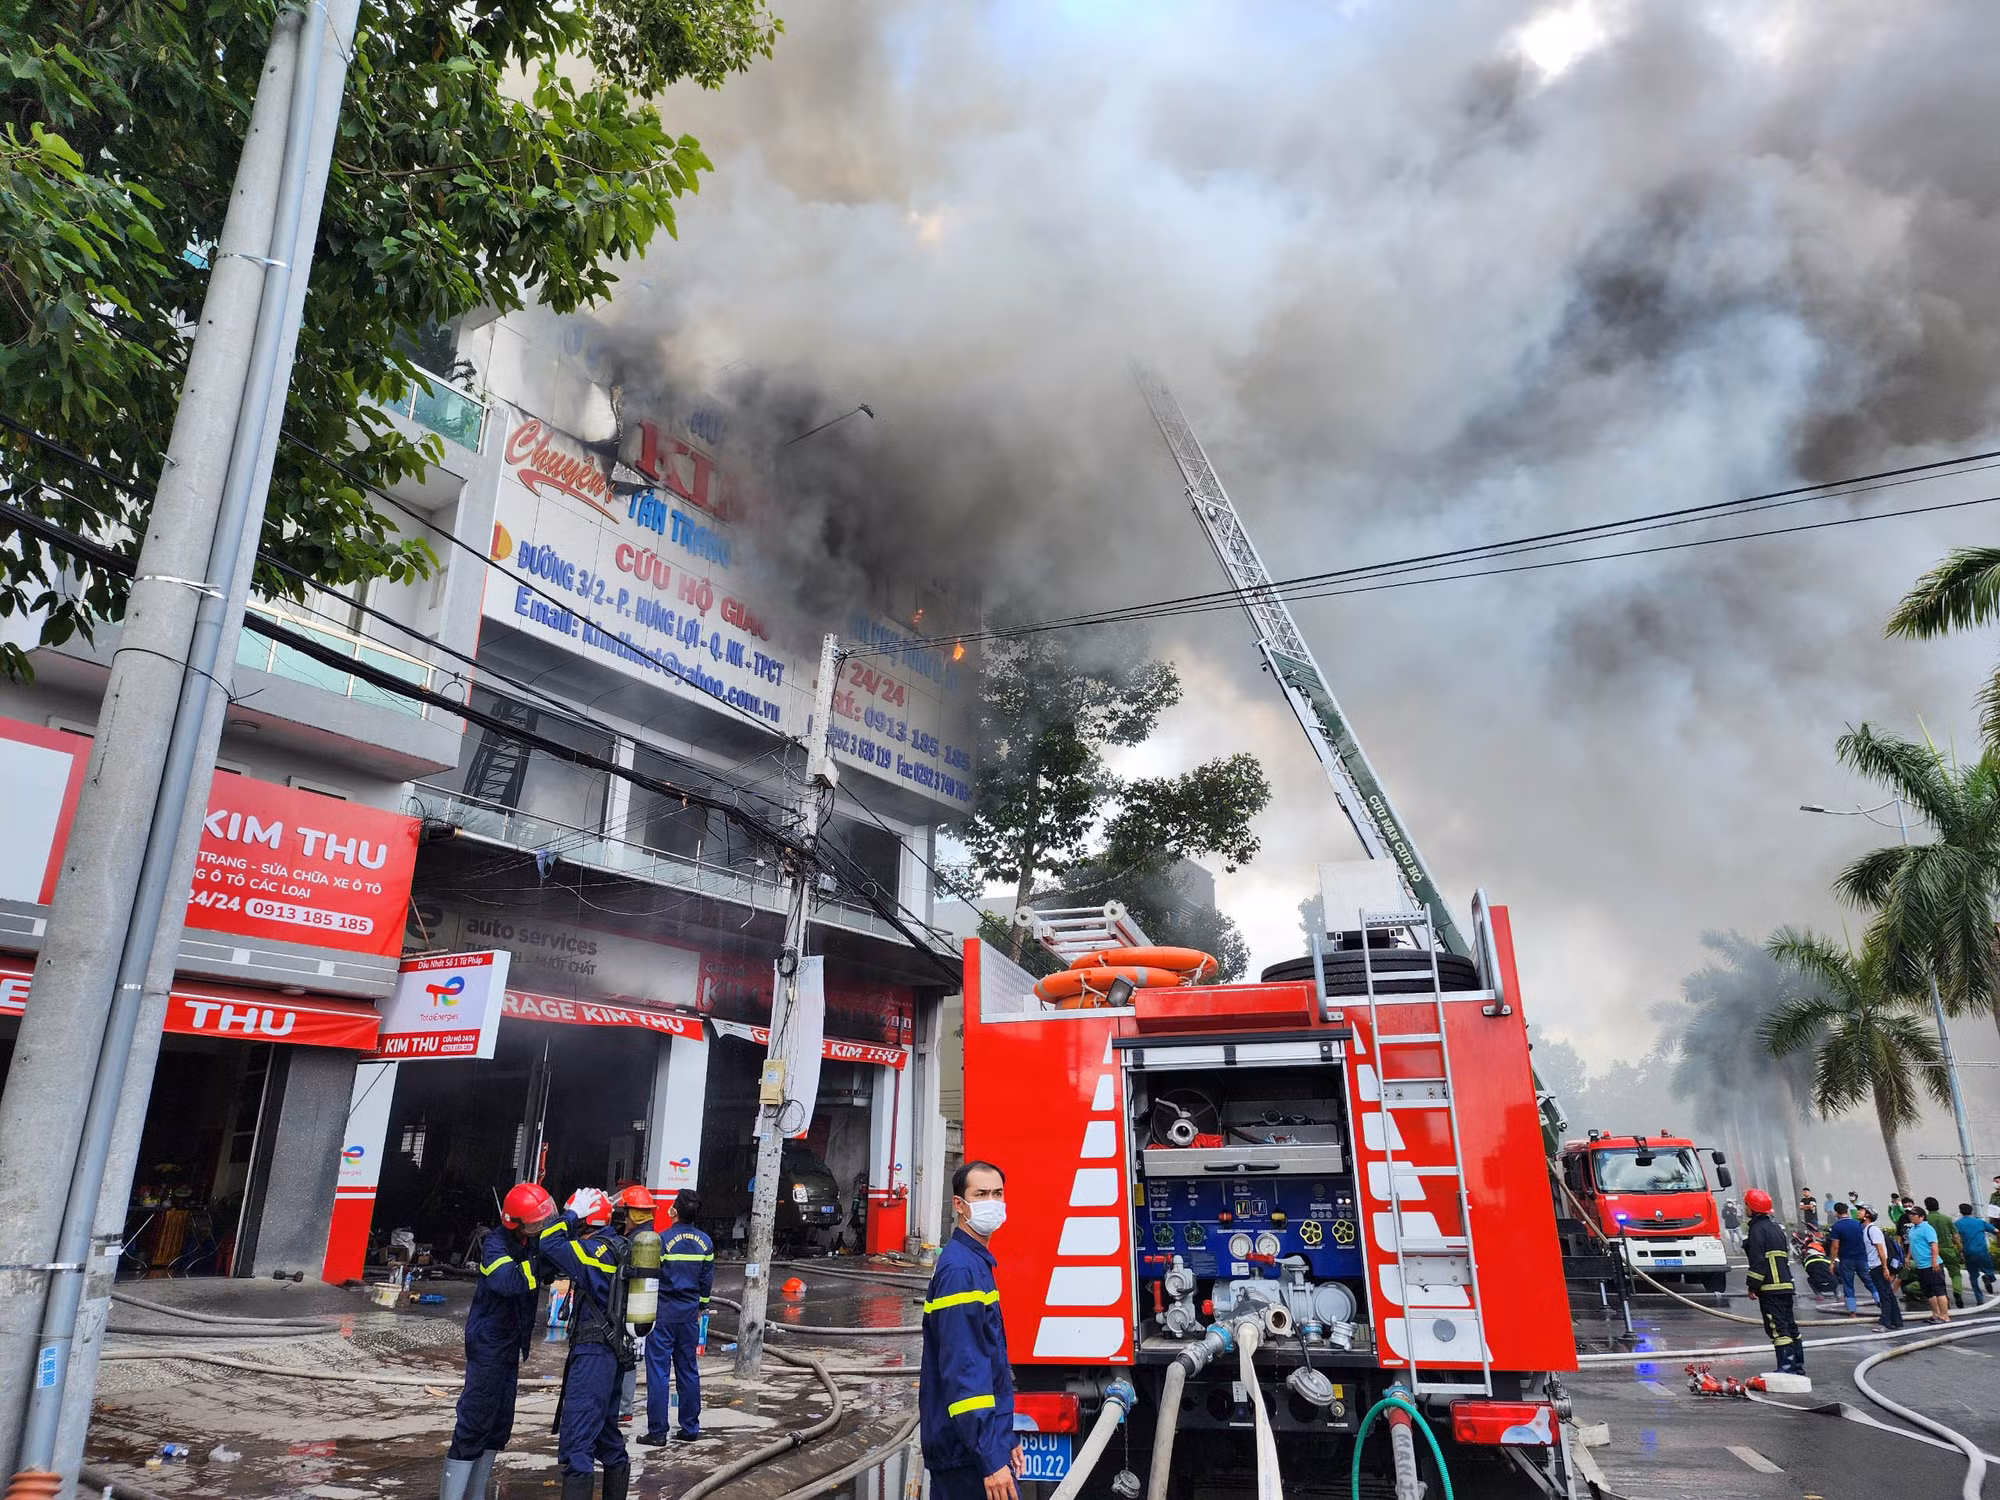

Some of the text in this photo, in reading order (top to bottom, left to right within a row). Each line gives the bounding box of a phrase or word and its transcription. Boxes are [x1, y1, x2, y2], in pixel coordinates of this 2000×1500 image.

[634, 418, 742, 526] KI
[615, 543, 671, 591] CỨU
[678, 577, 714, 617] HỘ
[515, 585, 580, 638] Email:
[517, 541, 575, 593] ĐƯỜNG
[576, 569, 606, 606] 3/2
[616, 588, 631, 618] P.
[676, 616, 700, 650] LỢI
[710, 631, 723, 662] Q.
[725, 637, 745, 669] NK
[753, 651, 785, 687] TPCT
[850, 662, 905, 708] 24/24
[864, 706, 907, 742] 0913
[911, 729, 939, 758] 185
[944, 745, 972, 772] 185
[202, 808, 388, 870] KIM THU
[1369, 794, 1425, 882] CỨU NẠN CỨU HỘ
[199, 850, 248, 870] TRANG
[261, 861, 289, 878] SỬA
[292, 868, 329, 886] CHỮA
[333, 877, 349, 889] XE
[352, 878, 363, 892] Ô
[365, 881, 382, 895] TÔ
[210, 869, 222, 882] Ô
[226, 873, 245, 887] TÔ
[249, 876, 279, 894] CÁC
[281, 883, 311, 899] LOẠI
[187, 889, 369, 932] 24/24 0913 185 185
[466, 918, 598, 956] auto services
[418, 960, 430, 969] Dầu
[430, 958, 445, 968] Nhớt
[445, 957, 454, 967] Số
[454, 957, 459, 966] 1
[467, 955, 483, 965] Pháp
[567, 959, 597, 976] CHẤT
[185, 1000, 296, 1036] THU
[419, 1012, 460, 1023] TotalEnergies
[502, 993, 577, 1022] RAGE
[583, 1006, 633, 1025] KIM
[384, 1037, 409, 1053] KIM
[412, 1036, 439, 1053] THU
[830, 1043, 863, 1059] KIM
